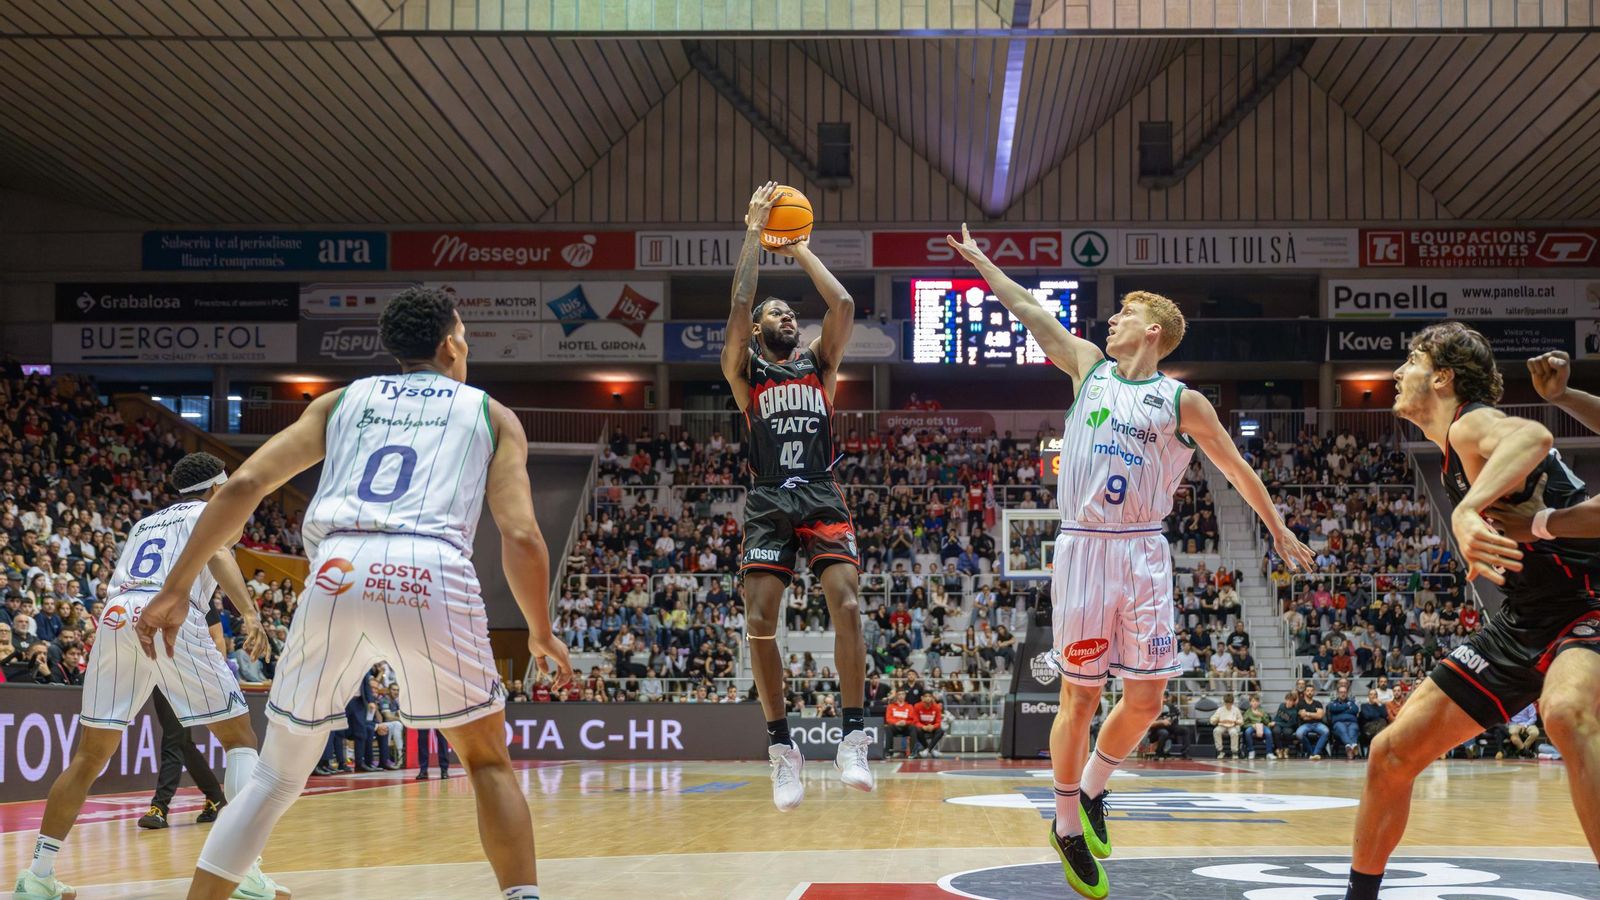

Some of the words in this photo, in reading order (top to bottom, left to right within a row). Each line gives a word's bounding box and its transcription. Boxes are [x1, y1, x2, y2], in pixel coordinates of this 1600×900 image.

[239, 236, 303, 251] periodisme
[1411, 231, 1537, 244] EQUIPACIONS
[317, 239, 371, 264] ara
[431, 234, 550, 266] Massegur
[675, 238, 732, 266] LLEAL
[1161, 237, 1219, 264] LLEAL
[1228, 233, 1296, 264] TULSÀ
[1418, 245, 1529, 257] ESPORTIVES
[100, 294, 181, 309] Grabalosa
[457, 297, 491, 307] AMPS
[495, 297, 536, 307] MOTOR
[1335, 285, 1447, 309] Panella
[1462, 285, 1555, 301] www.panella.cat
[559, 299, 581, 315] ibis
[619, 297, 648, 320] ibis
[81, 327, 265, 349] BUERGO.FOL
[559, 341, 598, 351] HOTEL
[601, 341, 647, 351] GIRONA
[1338, 333, 1391, 353] Kave
[380, 379, 454, 400] Tyson
[759, 384, 827, 419] GIRONA
[771, 417, 820, 434] FIATC
[887, 416, 923, 428] girona
[926, 416, 944, 426] ets
[946, 416, 958, 426] tu
[780, 441, 805, 469] 42
[358, 445, 418, 503] 0
[1105, 475, 1128, 505] 9
[152, 502, 197, 517] ylor
[130, 538, 167, 578] 6
[750, 548, 780, 561] YOSOY
[369, 563, 432, 583] COSTA
[365, 578, 395, 591] DEL
[400, 582, 432, 596] SOL
[362, 590, 430, 610] MÁLAGA
[1032, 669, 1059, 679] GIRONA
[1021, 702, 1060, 716] BeGre
[579, 719, 684, 751] C-HR
[788, 721, 878, 745] ndea
[0, 712, 158, 787] TOYTA
